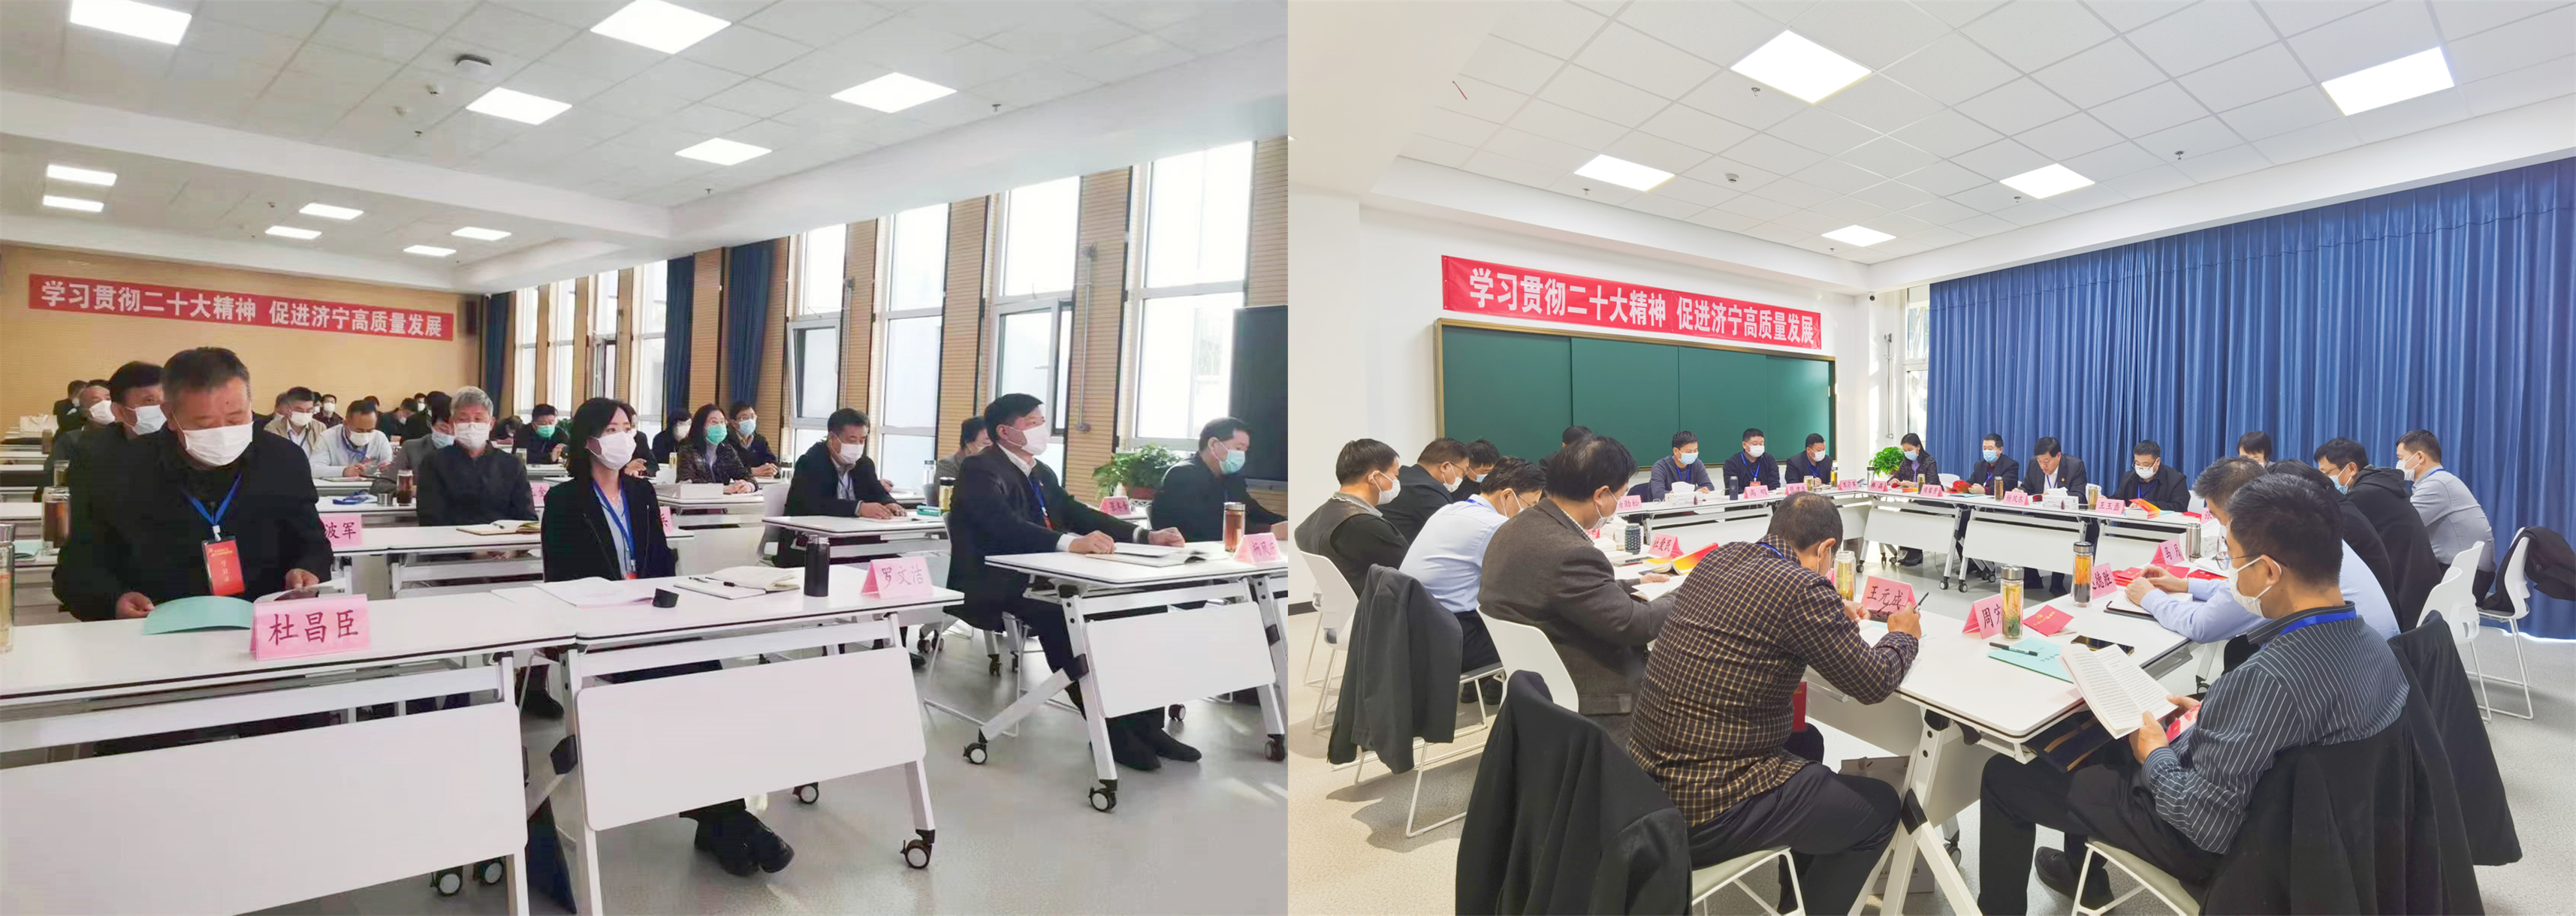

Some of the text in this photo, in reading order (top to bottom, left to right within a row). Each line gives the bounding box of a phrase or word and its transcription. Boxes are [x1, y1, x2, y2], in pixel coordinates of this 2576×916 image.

[41, 280, 442, 337] 学习贯彻二十大精神 促进济宁高质量发展
[1470, 267, 1814, 345] 学习贯彻二十大精神 促进济宁高质量发展
[2098, 502, 2121, 511] 王玉磊
[1651, 536, 1672, 552] 杜爱民
[1866, 586, 1904, 610] 王元成
[268, 609, 359, 646] 杜昌臣
